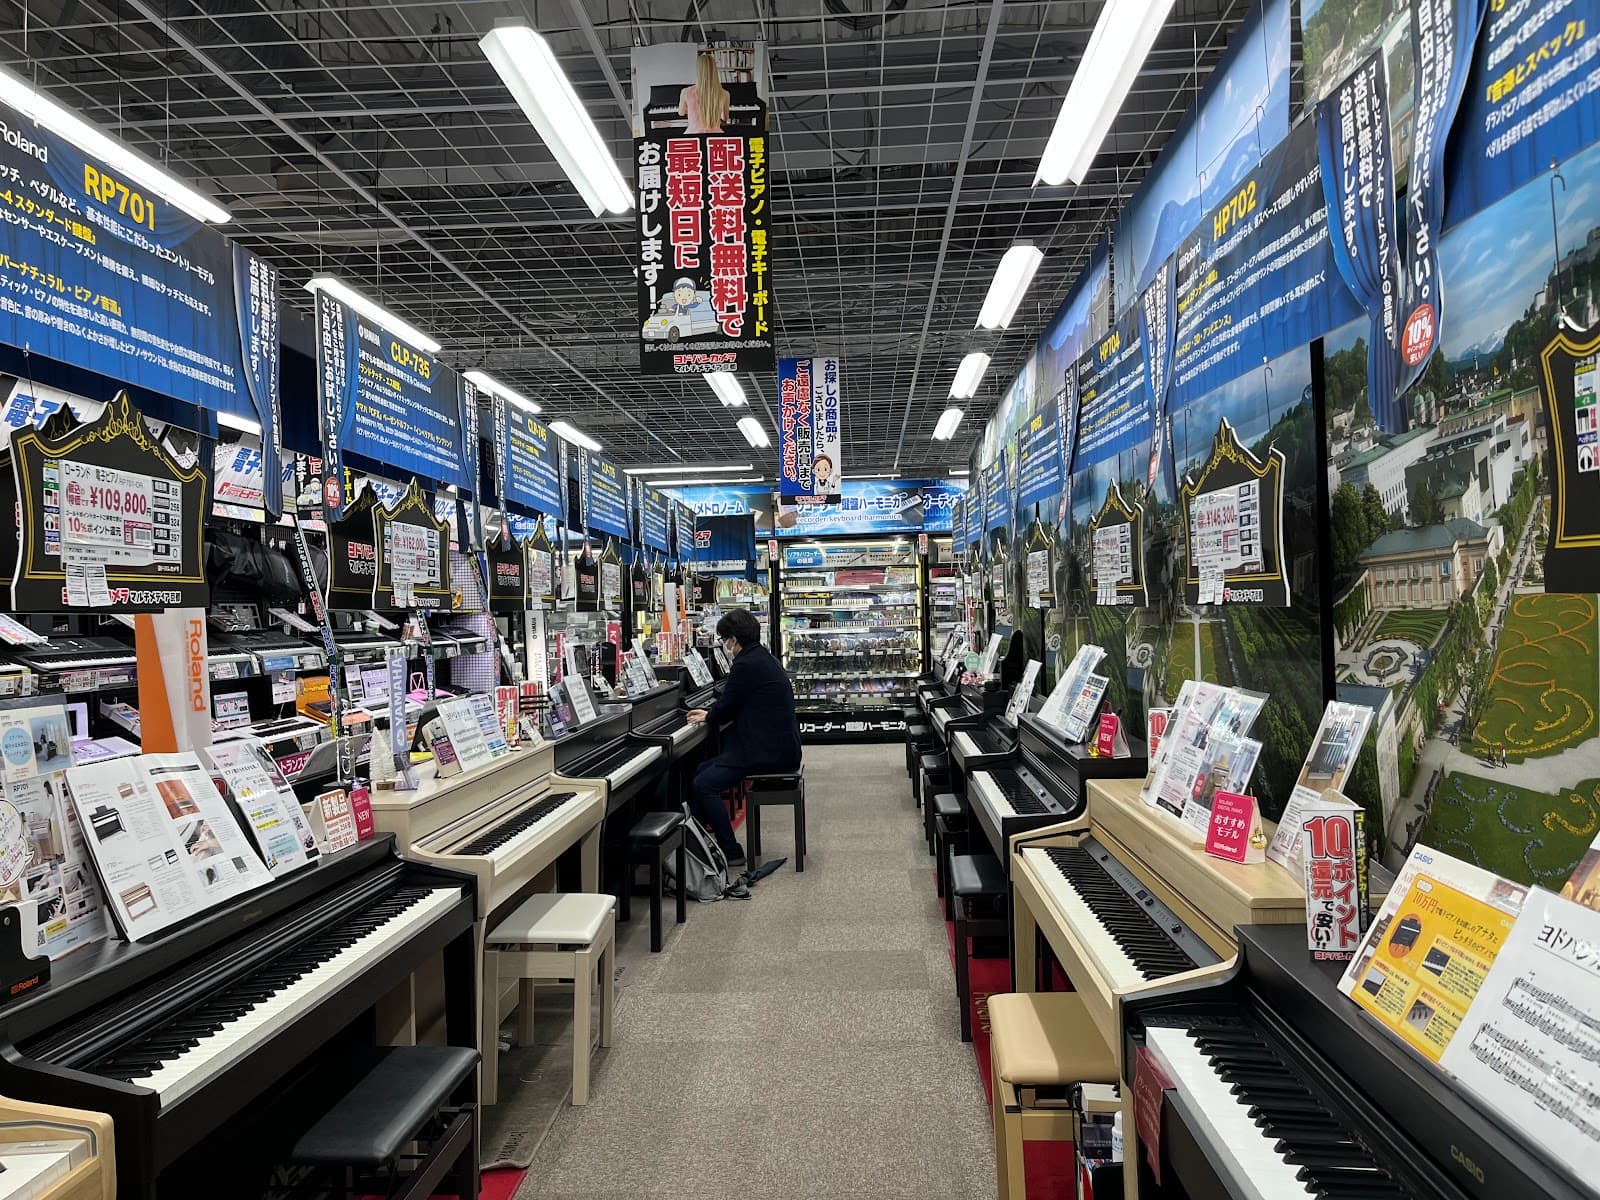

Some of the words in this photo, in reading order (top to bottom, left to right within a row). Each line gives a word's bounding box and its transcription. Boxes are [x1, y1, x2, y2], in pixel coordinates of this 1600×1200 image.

[1339, 86, 1359, 257] お届けします。
[1353, 69, 1374, 208] 送料無料で
[84, 163, 156, 232] RP701
[664, 136, 702, 270] 最短日に
[1213, 180, 1256, 243] HP702
[705, 135, 748, 338] 配送料無料で
[390, 341, 432, 379] CLP-735
[673, 353, 737, 364] ヨドバシカメラ
[1407, 314, 1432, 346] 10%
[781, 377, 797, 482] お声かけください。
[796, 359, 812, 491] ご遠慮なく販売員まで
[815, 385, 825, 453] ございましたら、
[824, 359, 838, 443] お探しの商品が
[188, 619, 207, 713] Roland
[13, 785, 29, 793] RP701
[1214, 814, 1246, 830] おすすめ
[1216, 826, 1240, 840] モデル
[1303, 816, 1351, 859] 10
[1413, 851, 1434, 865] CASIO
[1333, 859, 1358, 949] ポイント
[1450, 1144, 1486, 1185] CASIO
